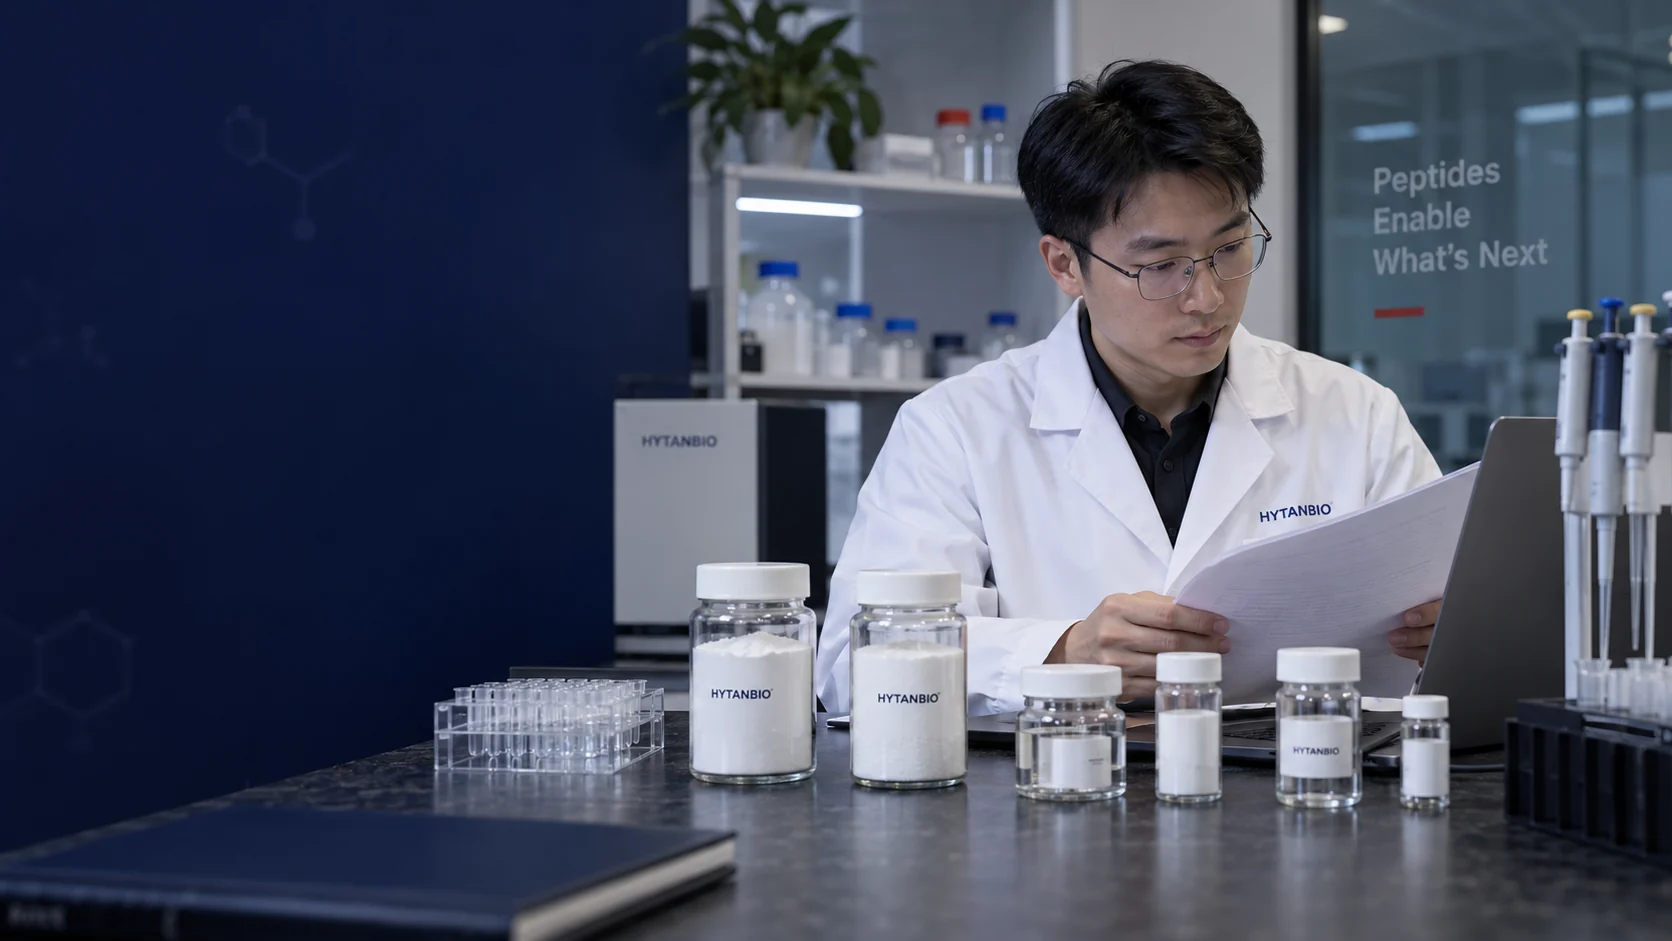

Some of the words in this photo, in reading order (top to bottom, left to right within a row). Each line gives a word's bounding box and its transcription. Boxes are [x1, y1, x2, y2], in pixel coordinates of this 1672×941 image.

[1373, 159, 1501, 198] Peptides
[1373, 200, 1471, 235] Enable
[1373, 243, 1469, 276] What’s
[1478, 238, 1548, 268] Next
[641, 434, 718, 448] HYTANBIO
[1259, 503, 1332, 523] HYTANBIO
[711, 688, 772, 700] HYTANBIO
[877, 692, 940, 704] HYTANBIO
[1292, 746, 1340, 756] HYTANBIO
